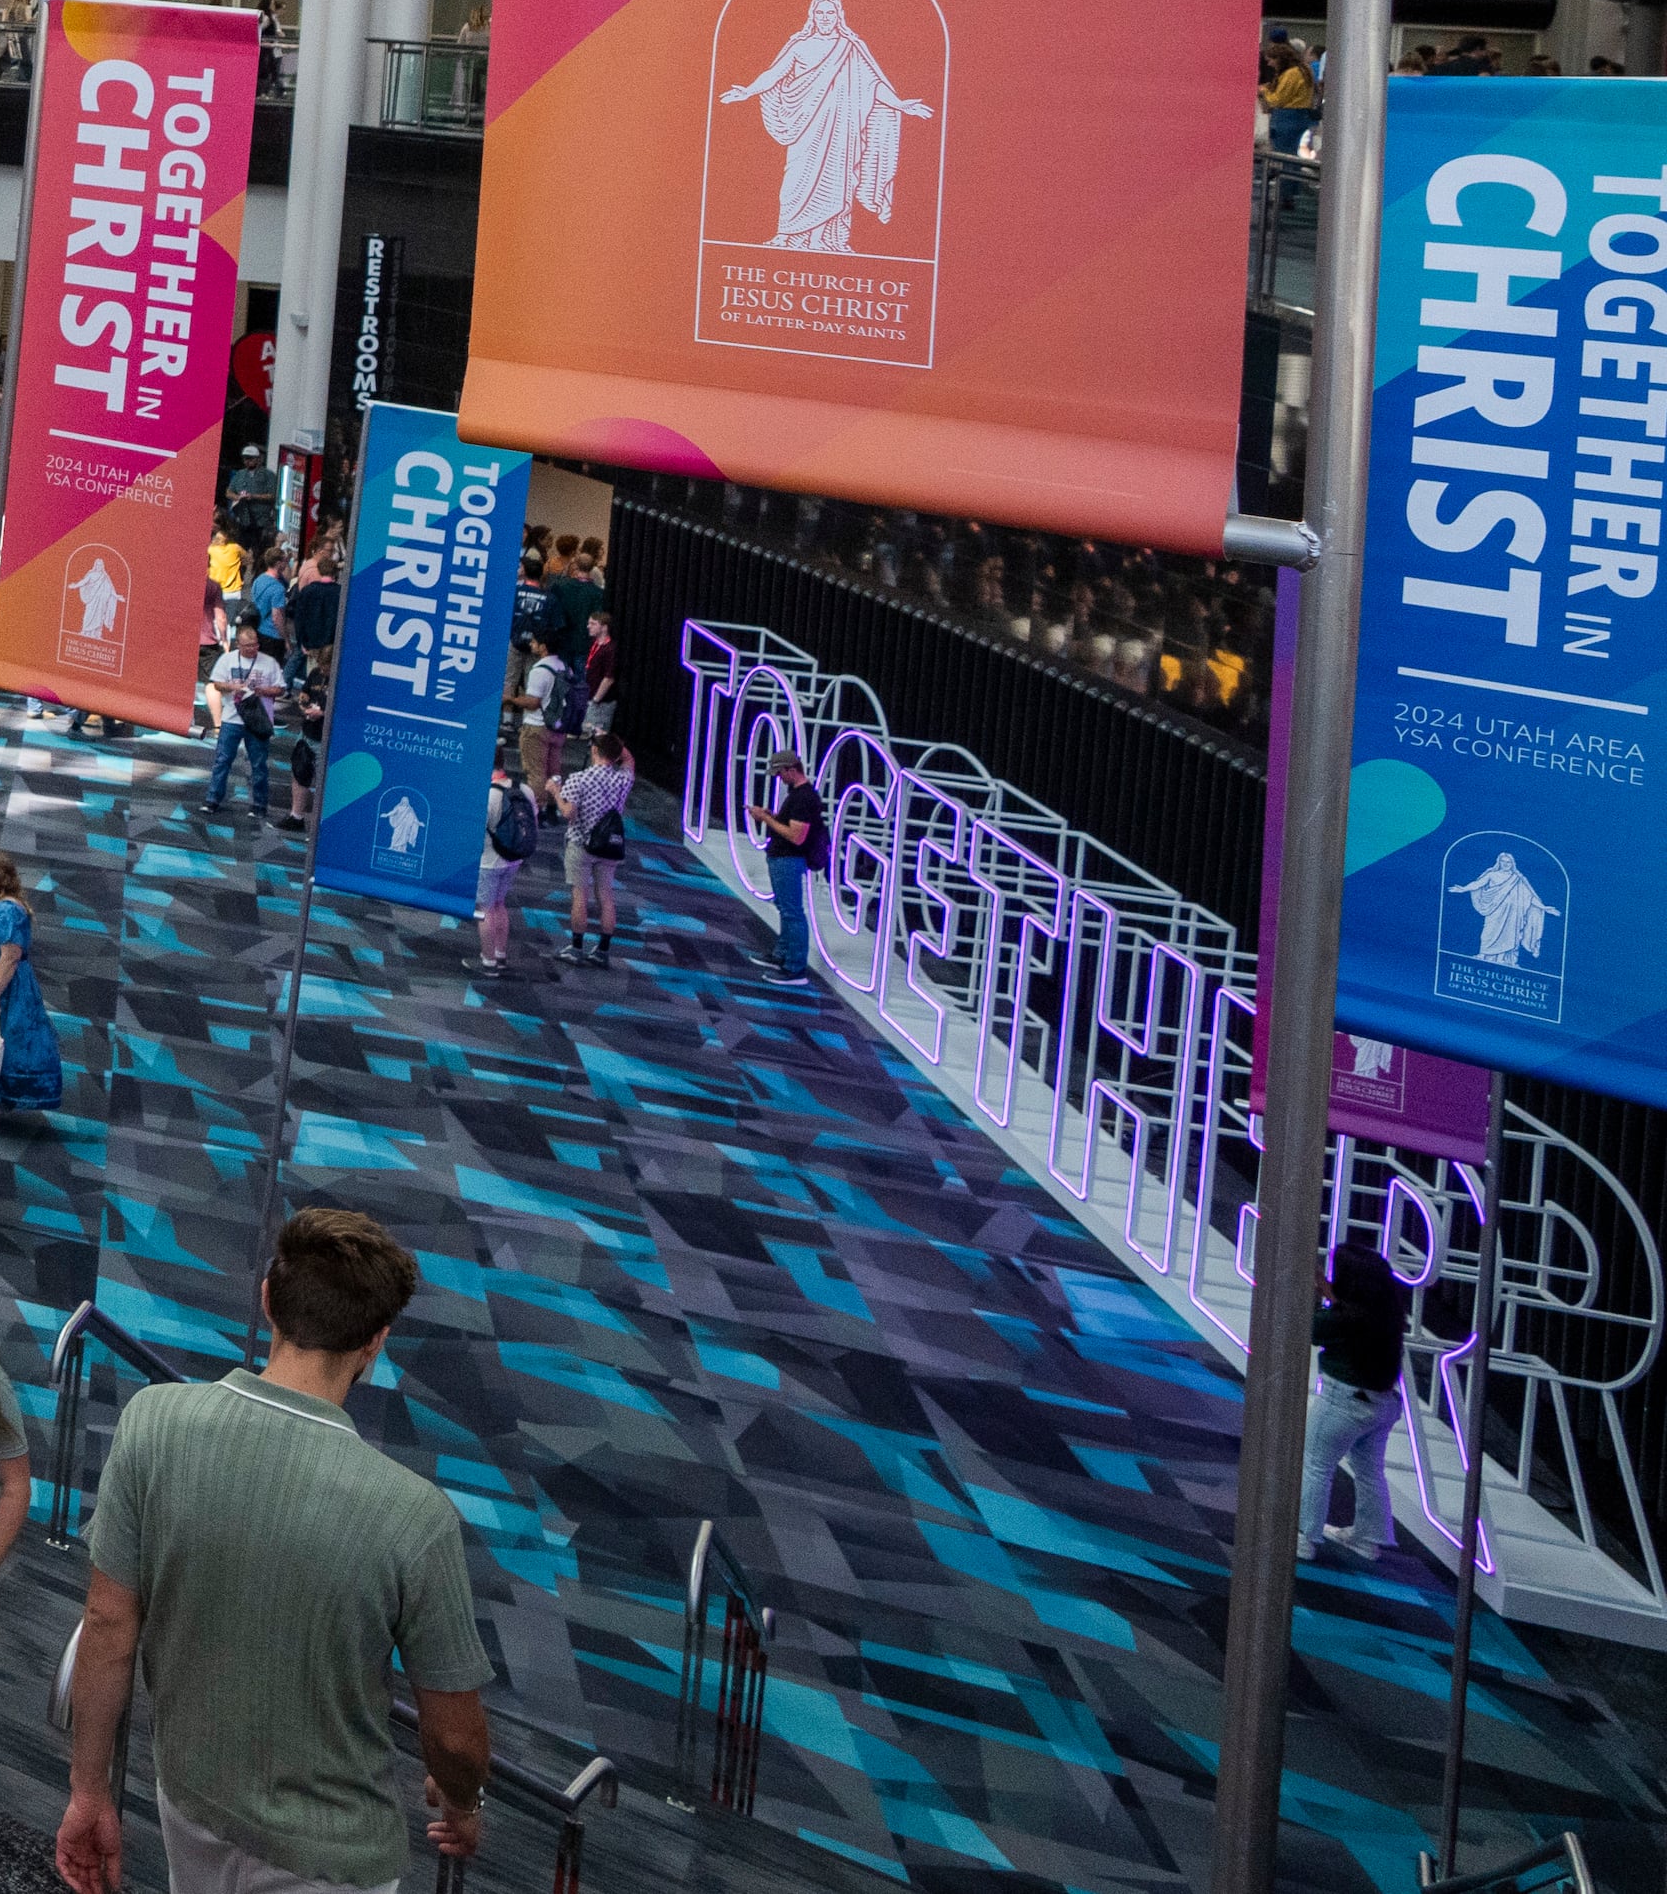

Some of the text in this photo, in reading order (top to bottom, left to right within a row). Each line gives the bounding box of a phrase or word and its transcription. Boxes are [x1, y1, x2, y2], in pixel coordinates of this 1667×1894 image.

[53, 58, 155, 413] CHRIST
[136, 68, 214, 419] TOGETHER IN
[721, 265, 911, 297] THE CHURCH OF
[720, 286, 909, 323] JESUS CHRIST
[353, 238, 384, 410] RESTROOMS
[720, 312, 906, 341] OF LATTER-DAY SAINTS
[1401, 153, 1567, 648] CHRIST
[1562, 162, 1667, 660] TOGETHER IN
[46, 455, 174, 491] 2024 UTAH AREA
[46, 471, 172, 508] YSA CONFERENCE
[371, 449, 454, 697] CHRIST
[433, 462, 500, 703] TOGETHER IN
[87, 649, 116, 663] CHRIST
[364, 723, 464, 752] 2024 UTAH AREA
[364, 735, 462, 764] YSA CONFERENCE
[1394, 703, 1645, 762] 2024 UTAH AREA
[1394, 726, 1644, 786] YSA CONFERENCE
[1449, 971, 1548, 1002] JESUS CHRIST
[1450, 962, 1548, 991] THE CHURCH OF
